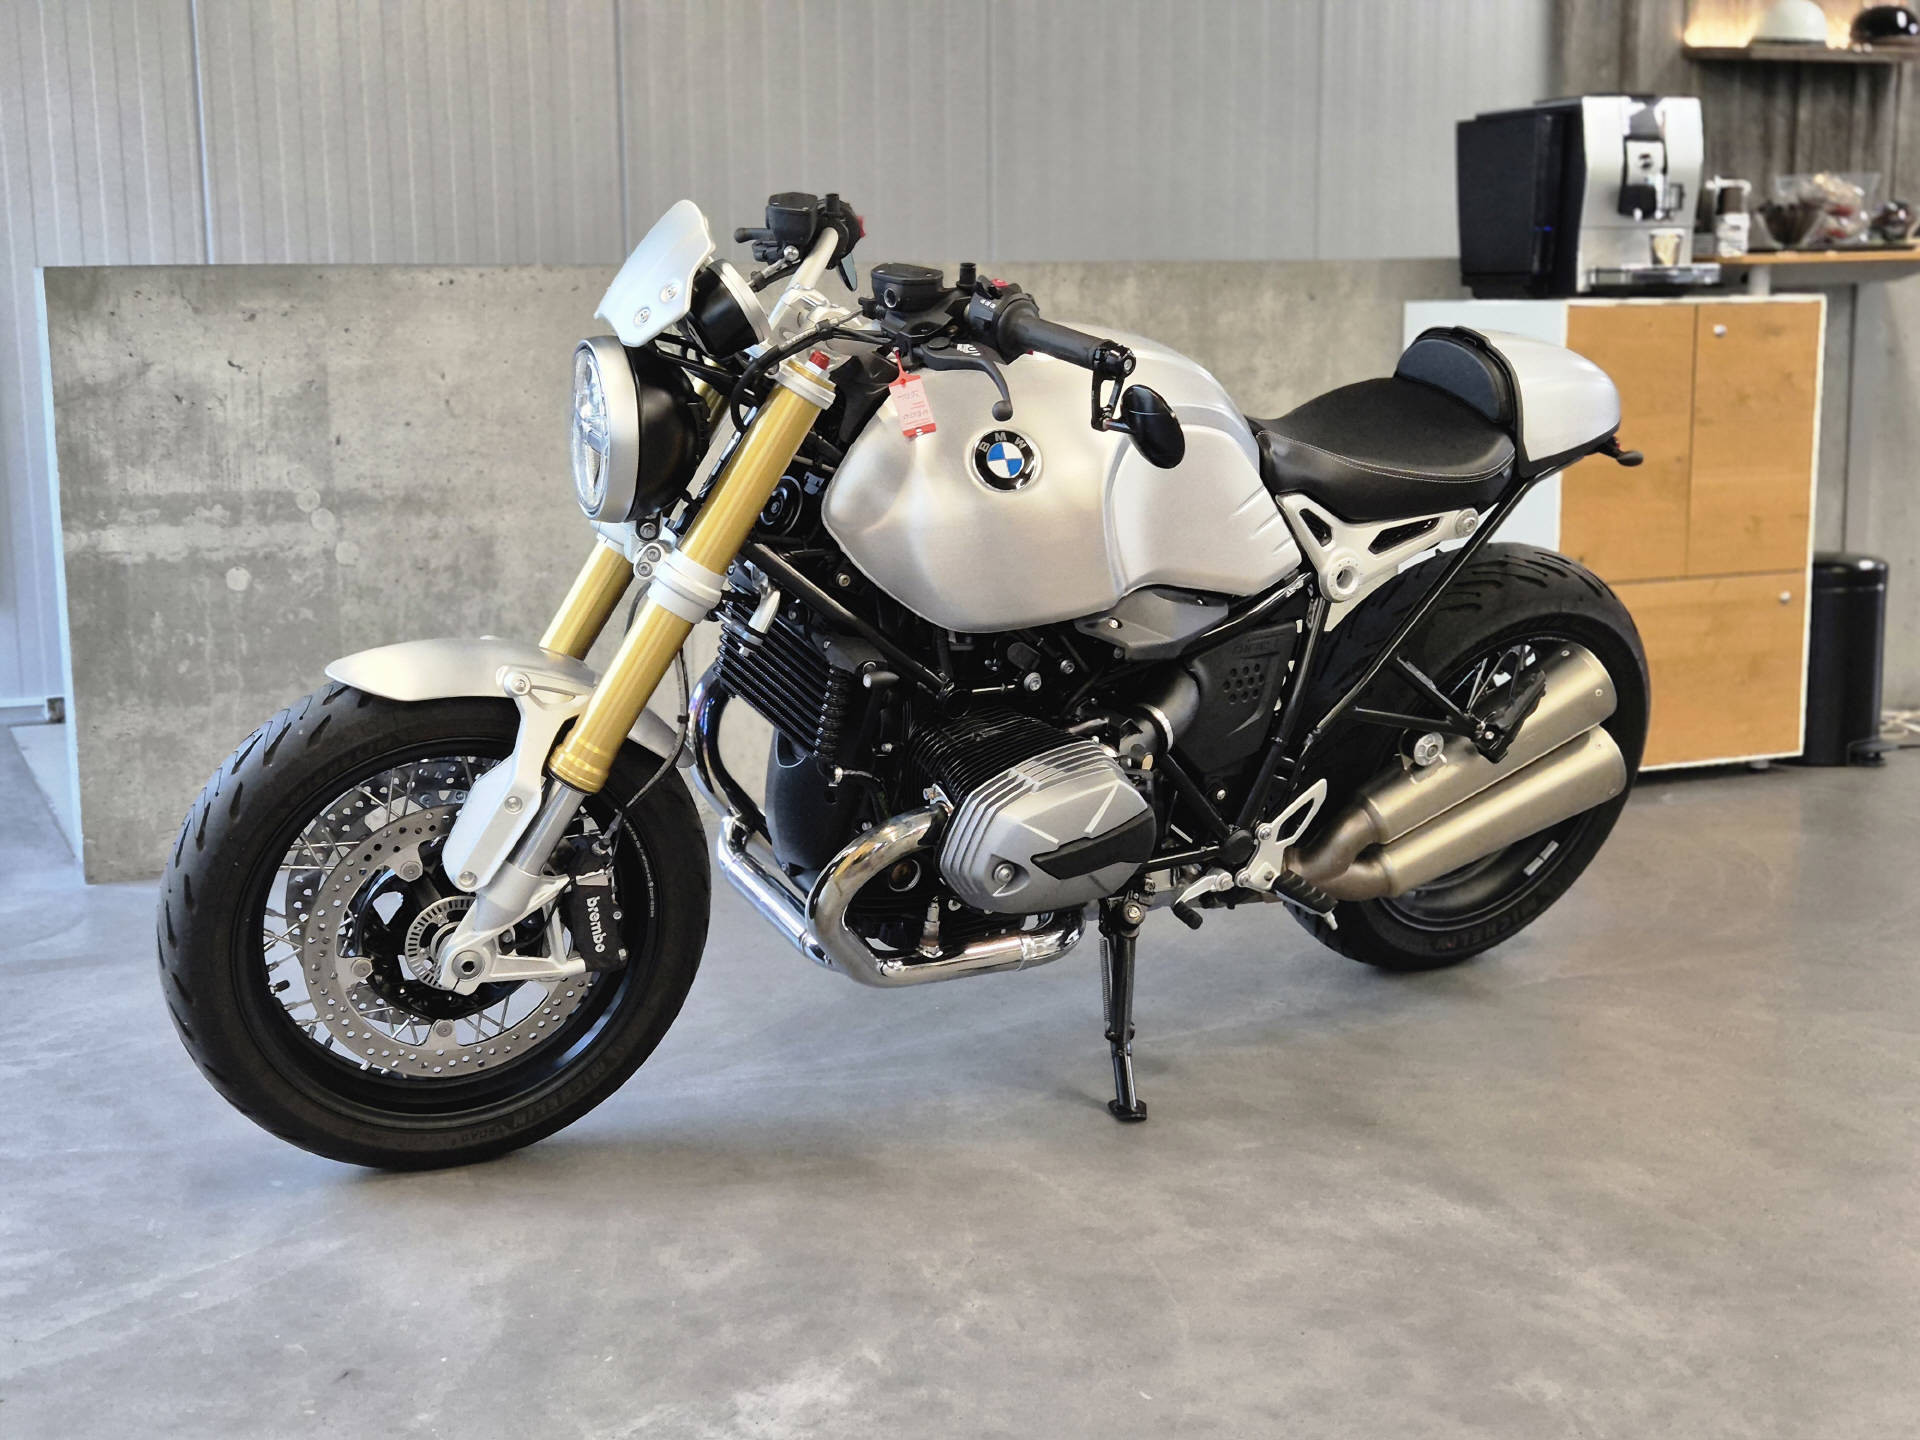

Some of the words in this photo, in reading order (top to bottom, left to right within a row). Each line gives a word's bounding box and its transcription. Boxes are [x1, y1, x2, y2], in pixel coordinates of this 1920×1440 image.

[978, 431, 1028, 453] BMW
[586, 895, 607, 953] brembo
[1433, 898, 1539, 951] MICHELIN
